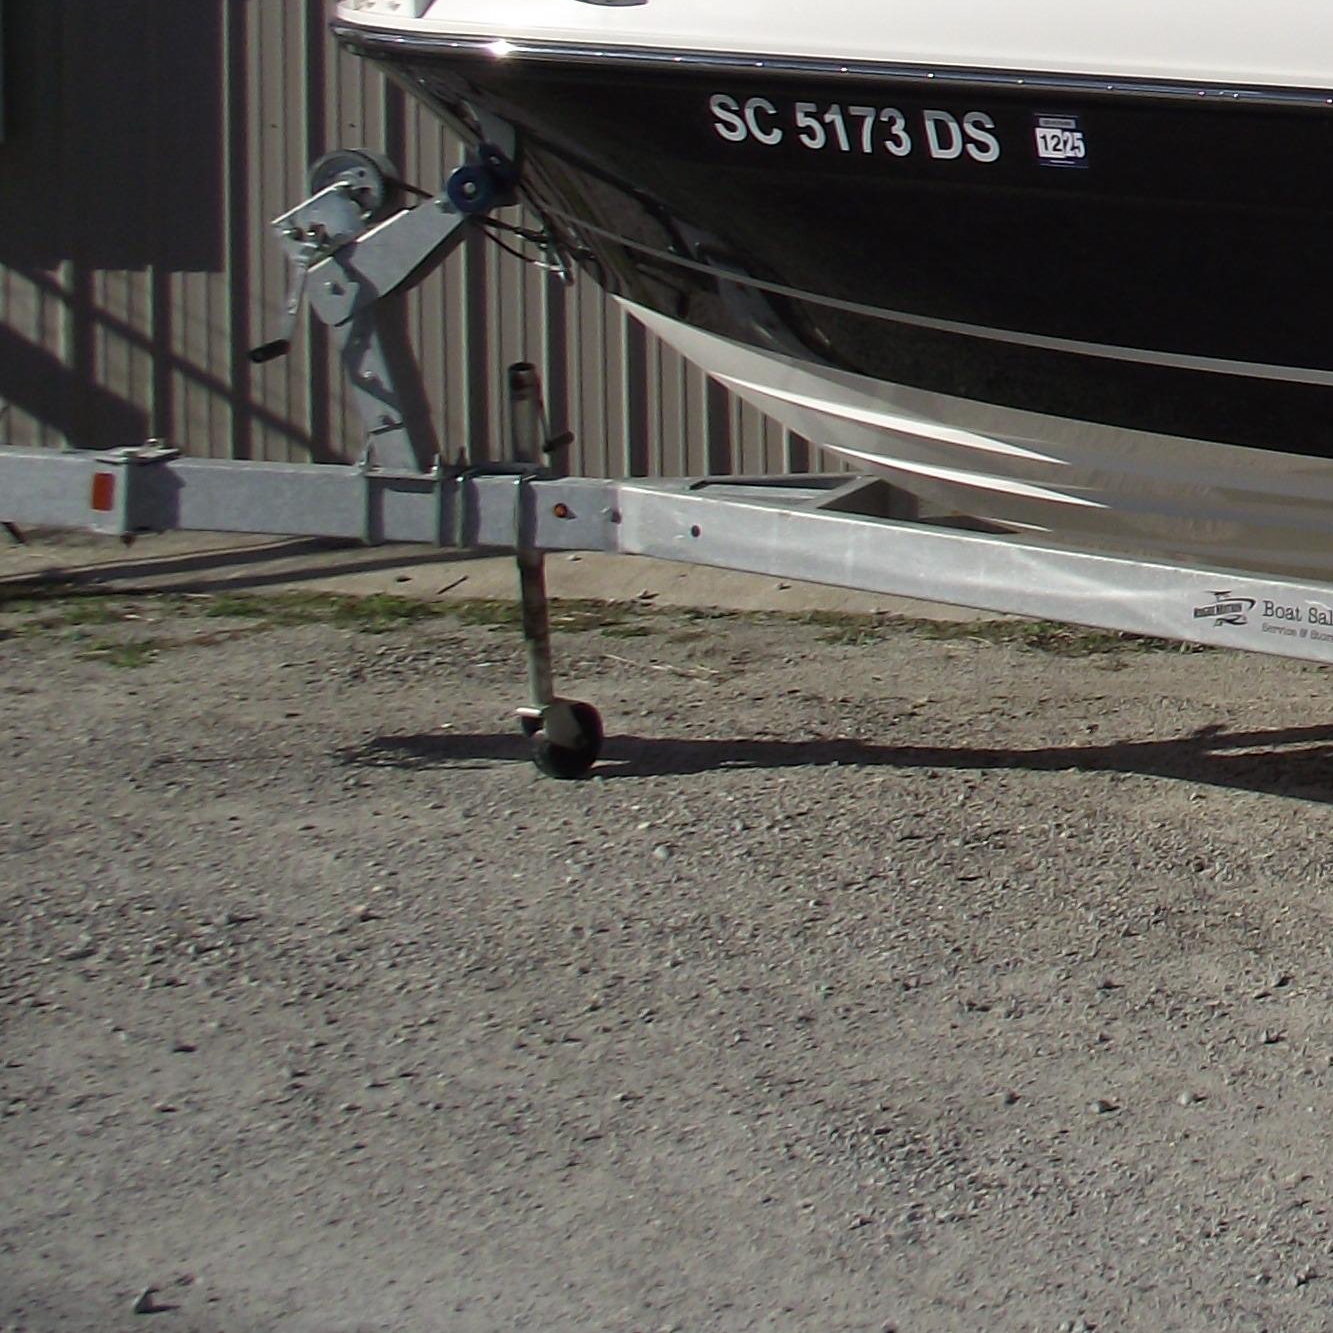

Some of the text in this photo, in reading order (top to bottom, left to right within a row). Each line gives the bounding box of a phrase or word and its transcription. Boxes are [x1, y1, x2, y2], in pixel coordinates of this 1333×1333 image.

[709, 94, 1001, 163] SC 5173 DS
[1262, 600, 1302, 622] Boat
